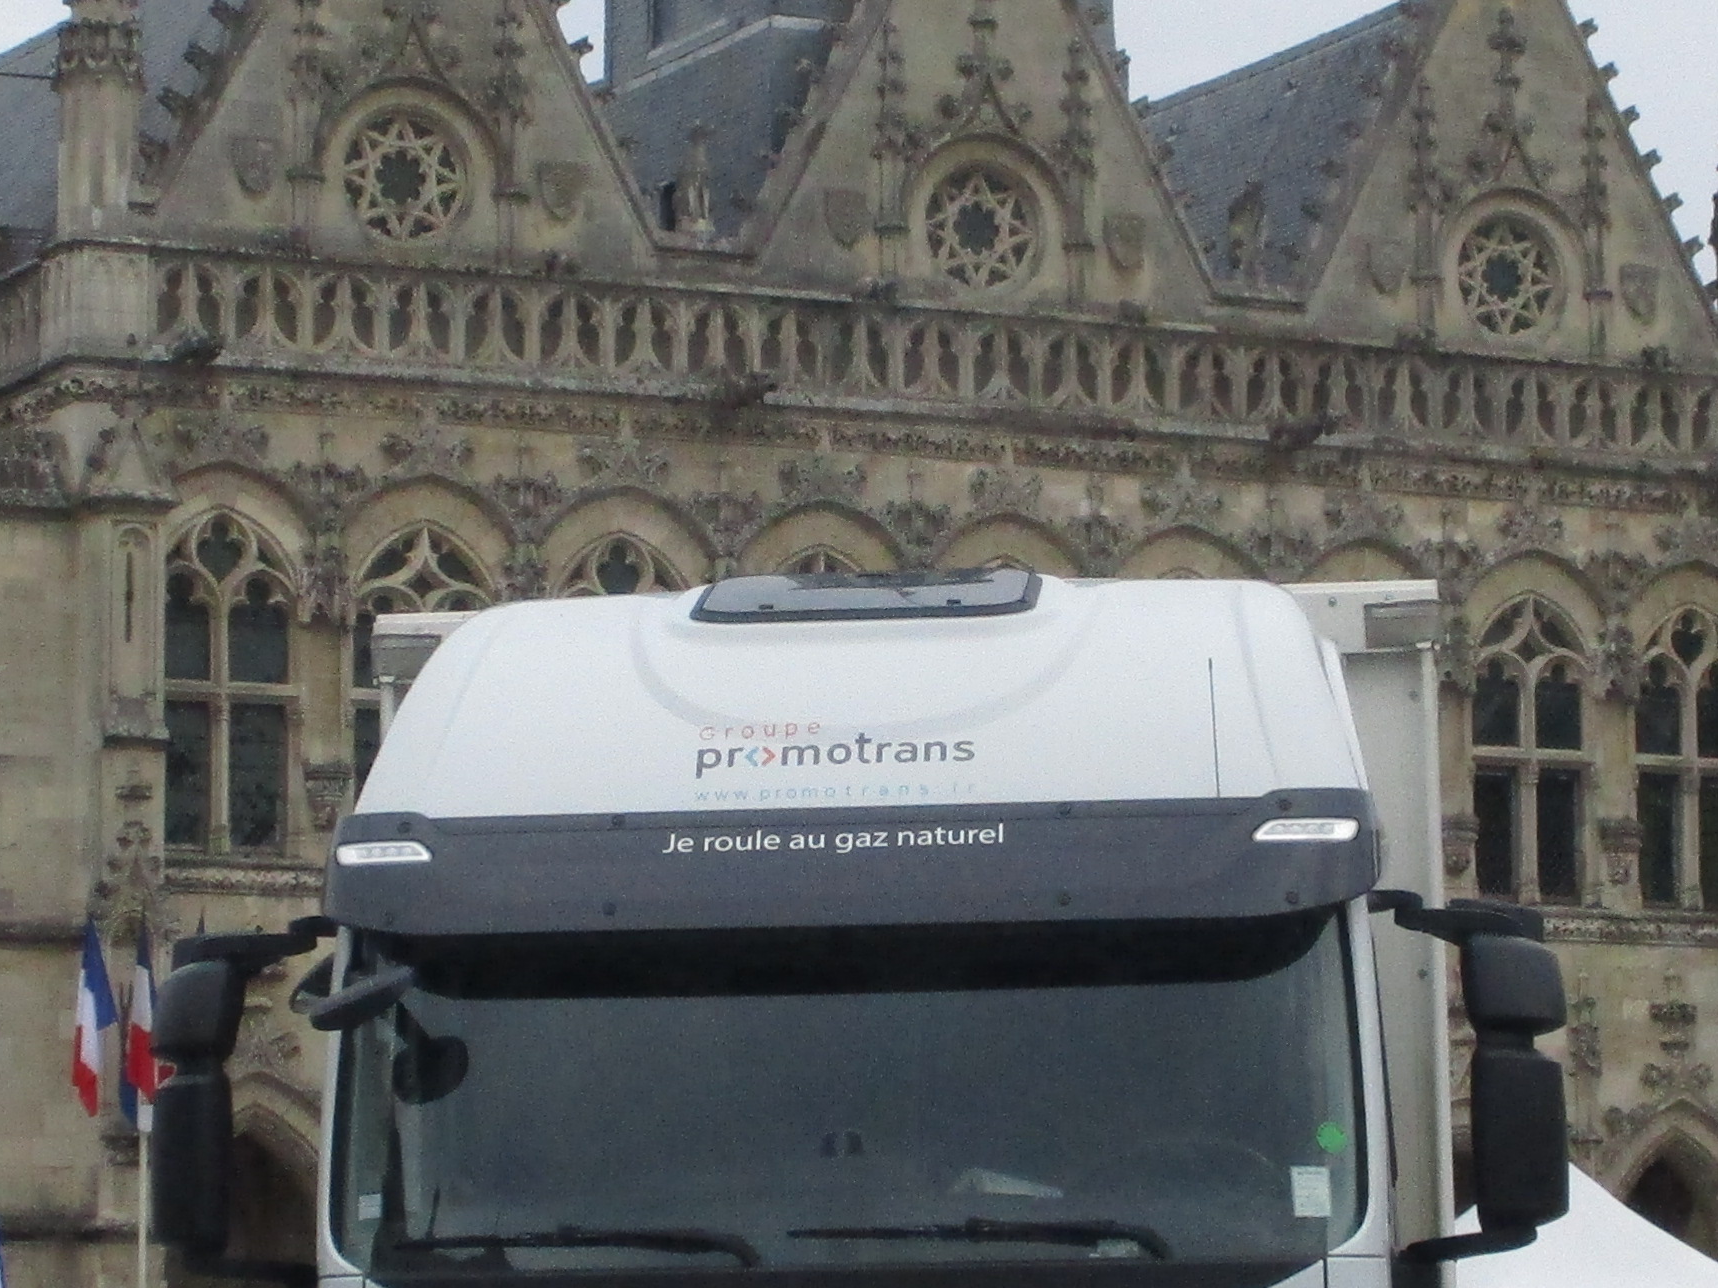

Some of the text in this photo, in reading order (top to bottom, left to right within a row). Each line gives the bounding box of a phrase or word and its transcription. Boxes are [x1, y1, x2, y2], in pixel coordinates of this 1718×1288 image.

[698, 720, 821, 741] Groupe
[662, 823, 1005, 854] Je roule au gaz naturel
